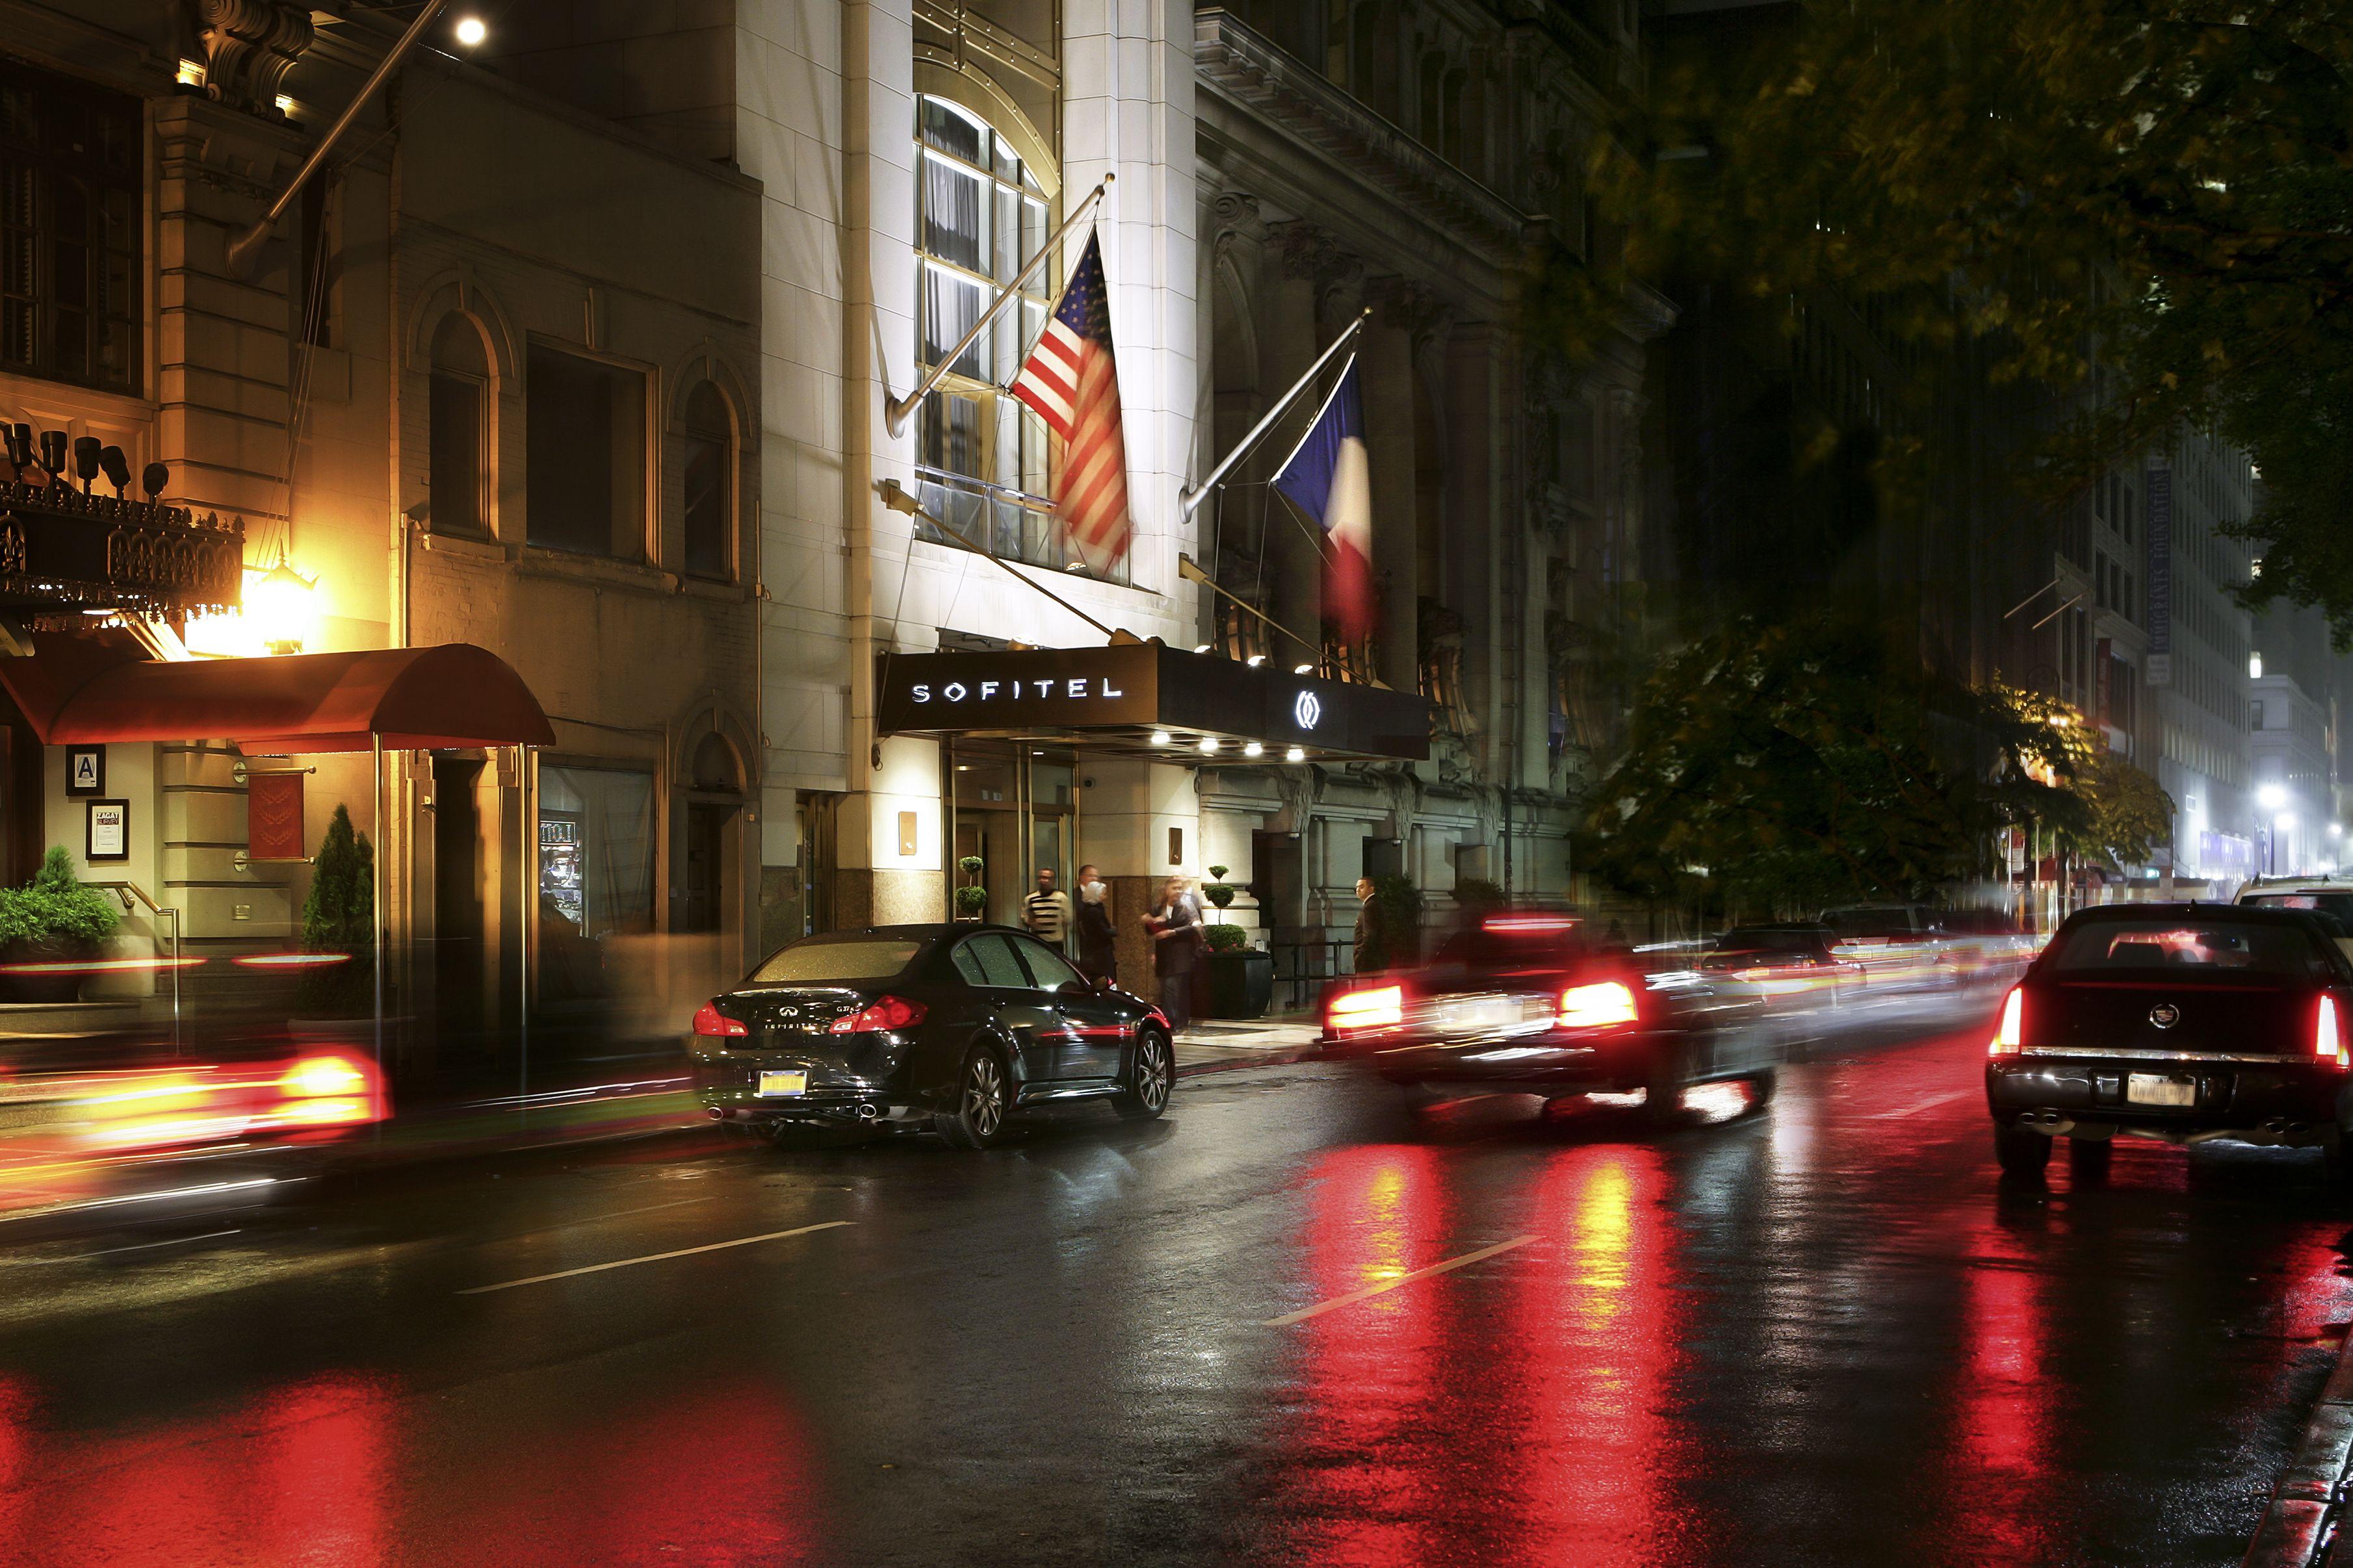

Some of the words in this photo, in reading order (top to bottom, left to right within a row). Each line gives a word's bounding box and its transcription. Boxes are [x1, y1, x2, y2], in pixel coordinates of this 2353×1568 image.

[2153, 473, 2169, 559] FOUNDATION
[2153, 568, 2169, 650] IMMIGRANTS
[912, 678, 1122, 702] SOFITEL
[78, 756, 94, 778] A
